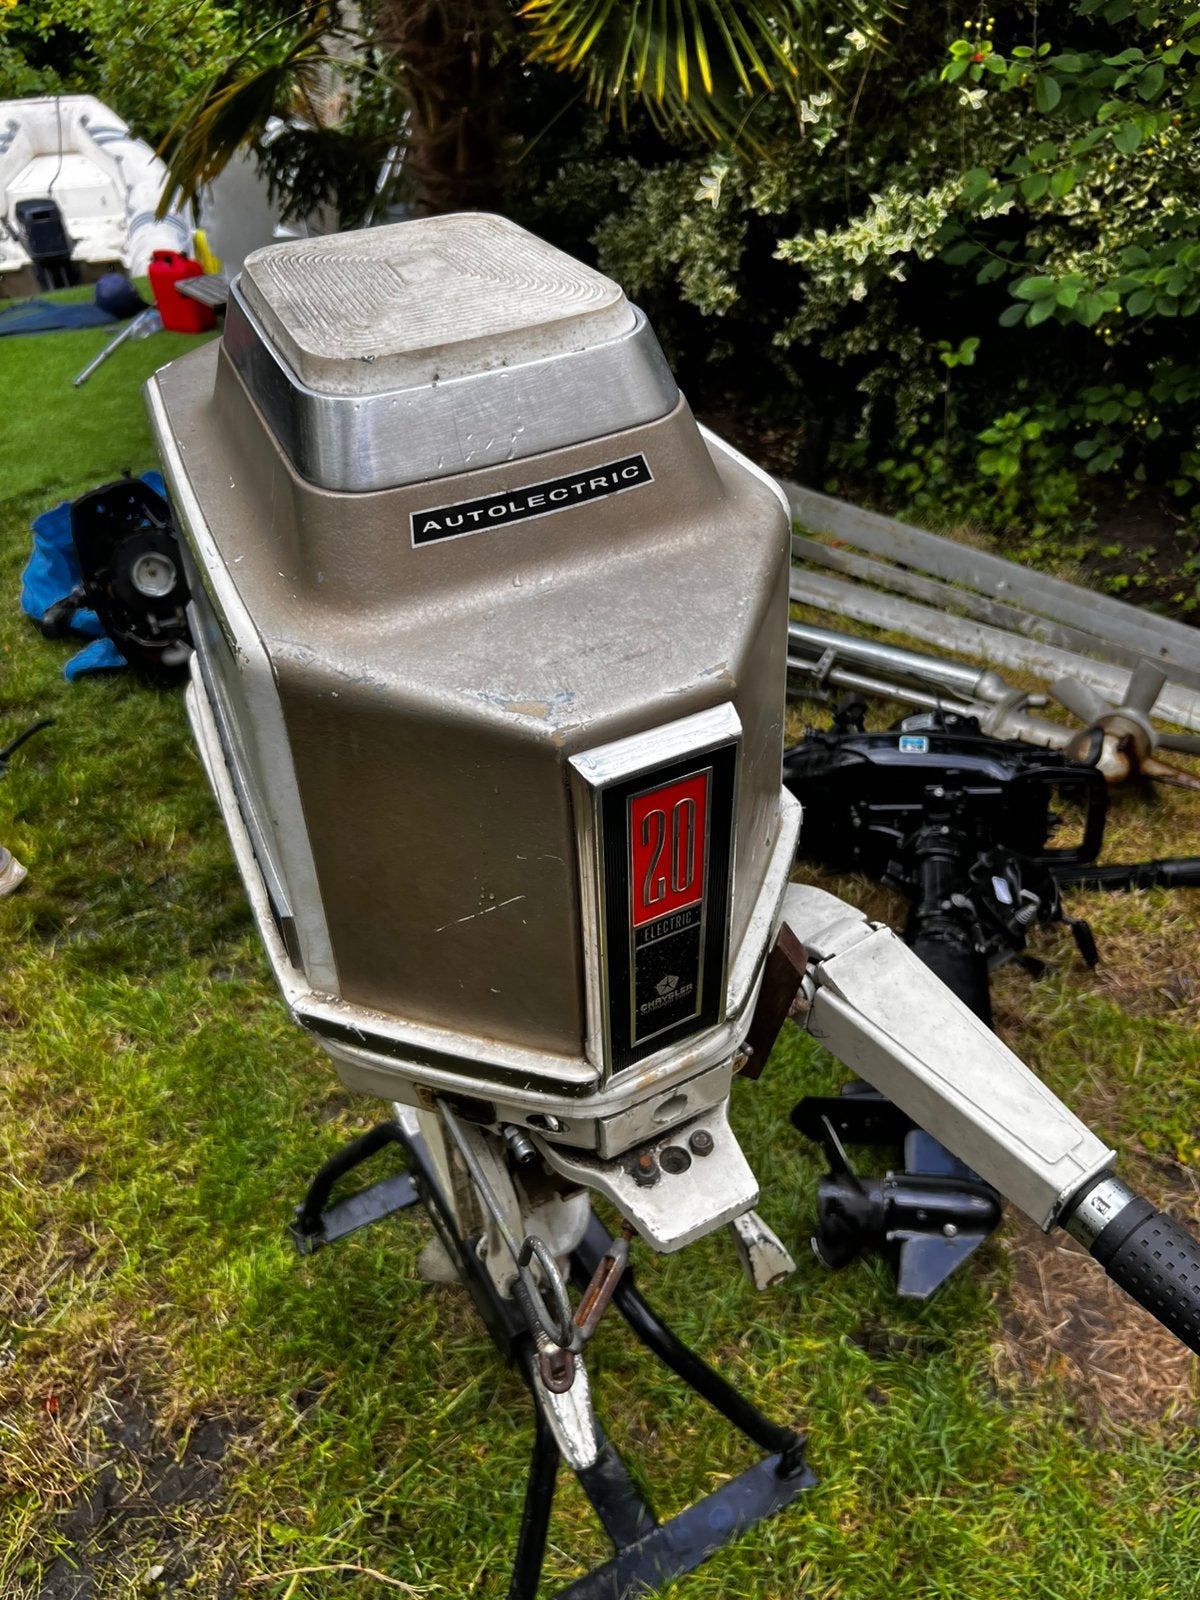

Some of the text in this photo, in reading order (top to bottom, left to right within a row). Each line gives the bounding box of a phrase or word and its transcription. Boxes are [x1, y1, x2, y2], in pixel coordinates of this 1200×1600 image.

[422, 465, 640, 533] AUTOLECTRIC
[641, 798, 696, 907] 20
[644, 910, 692, 941] ELECTRIC
[640, 983, 693, 1012] CHRYSLER
